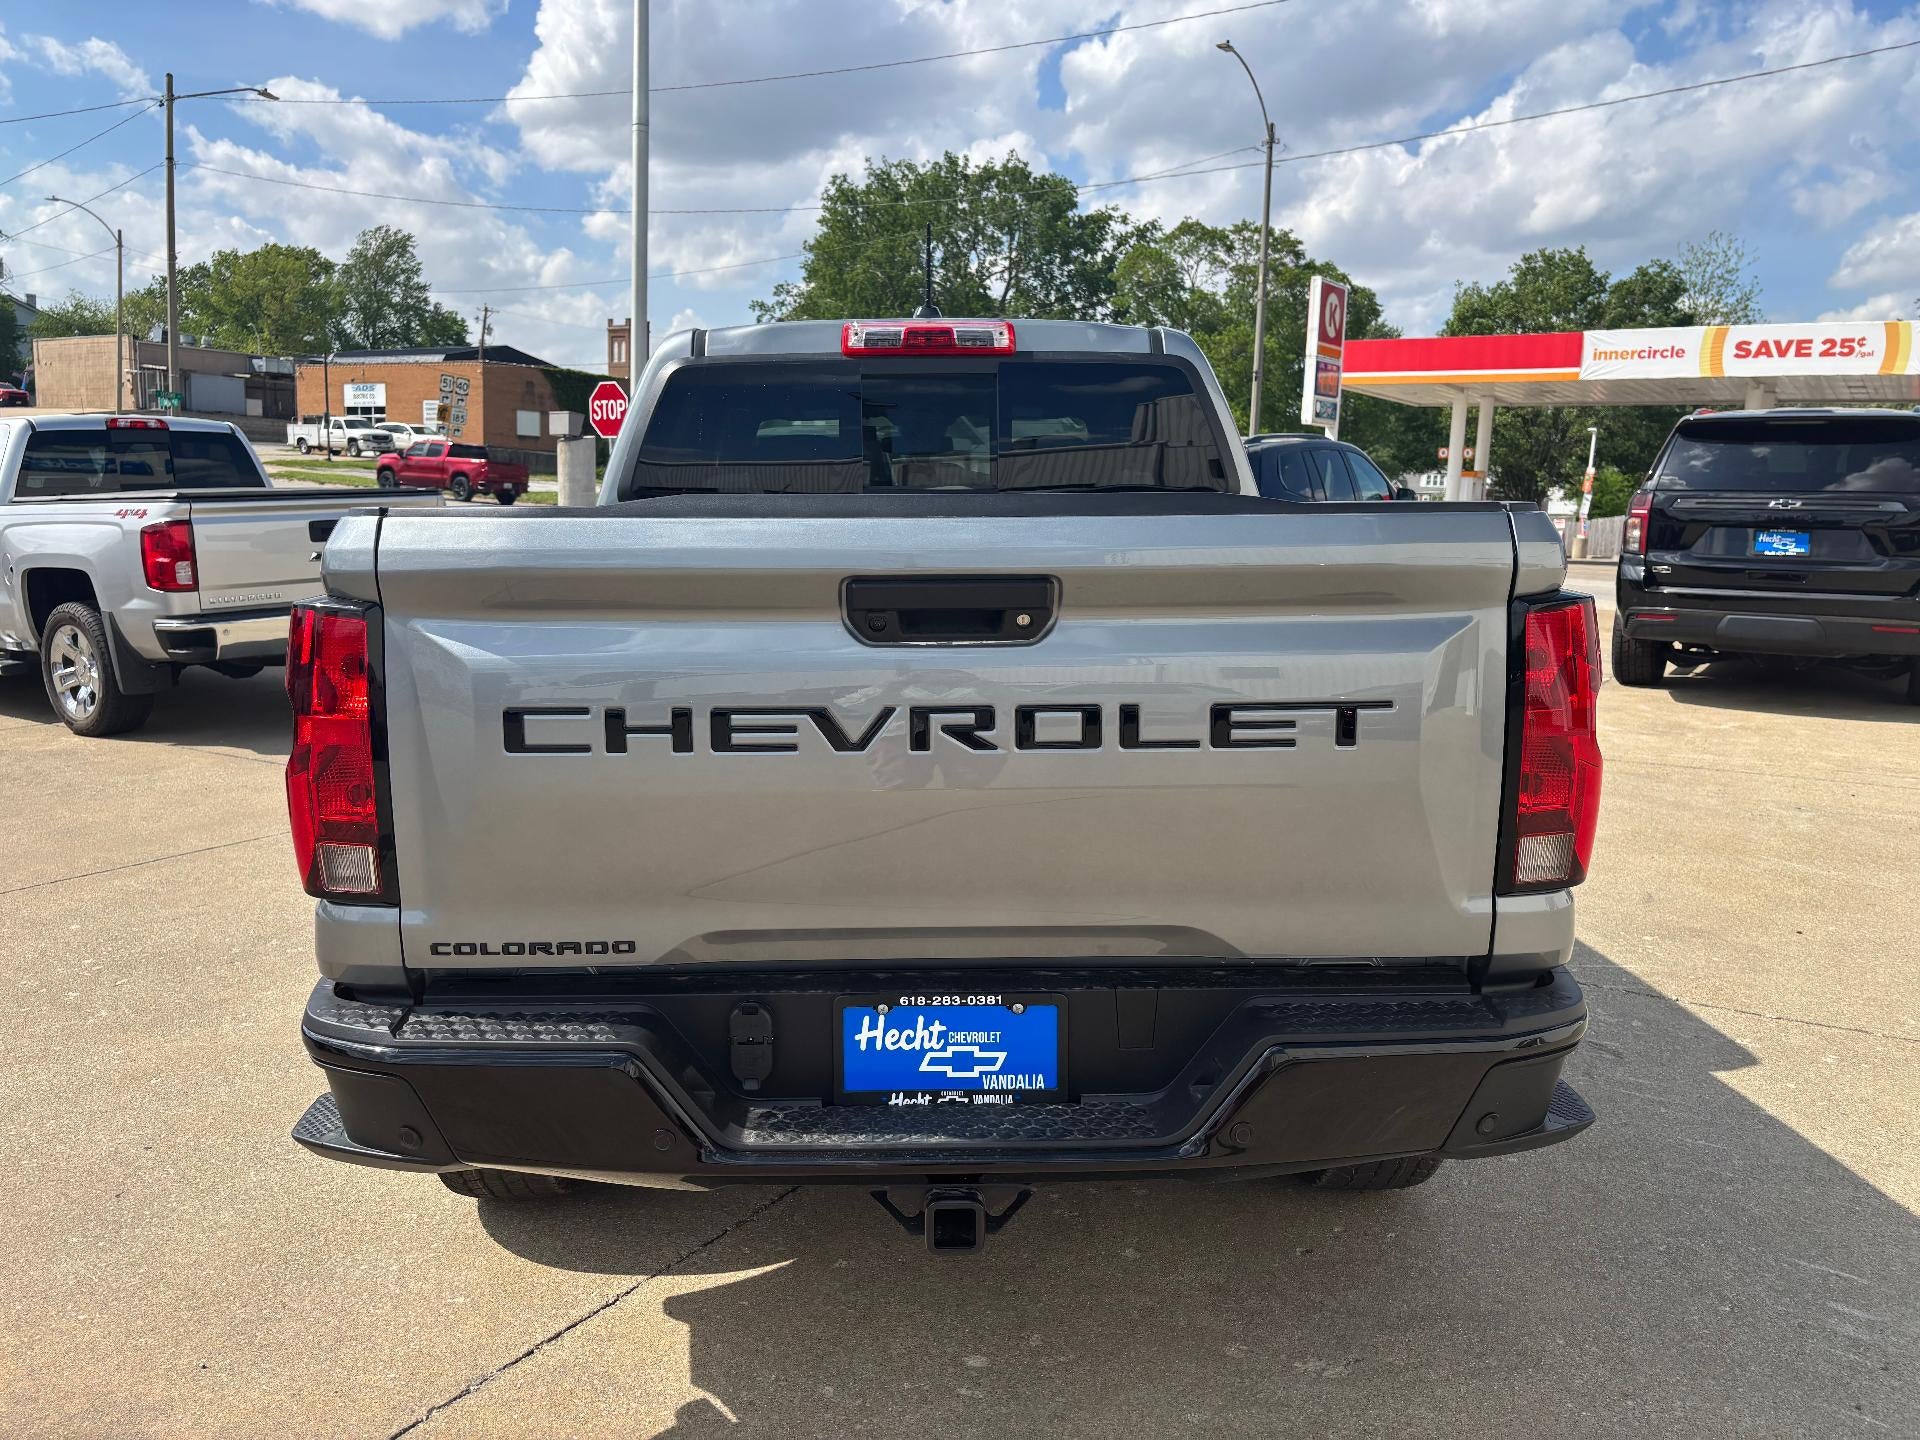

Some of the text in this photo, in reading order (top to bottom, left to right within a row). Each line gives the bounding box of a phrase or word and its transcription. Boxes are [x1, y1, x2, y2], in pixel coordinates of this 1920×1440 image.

[1593, 346, 1685, 361] innercircle
[1734, 339, 1813, 359] SAVE
[443, 378, 452, 389] 51
[457, 381, 468, 391] 40
[593, 399, 625, 420] STOP
[453, 413, 466, 423] 185
[503, 701, 1395, 753] CHEVROLET
[430, 940, 636, 956] COLORADO
[900, 995, 1002, 1006] 618-283-0381
[855, 1015, 1001, 1050] Hecht CHEVROLET
[982, 1074, 1045, 1090] VANDALIA
